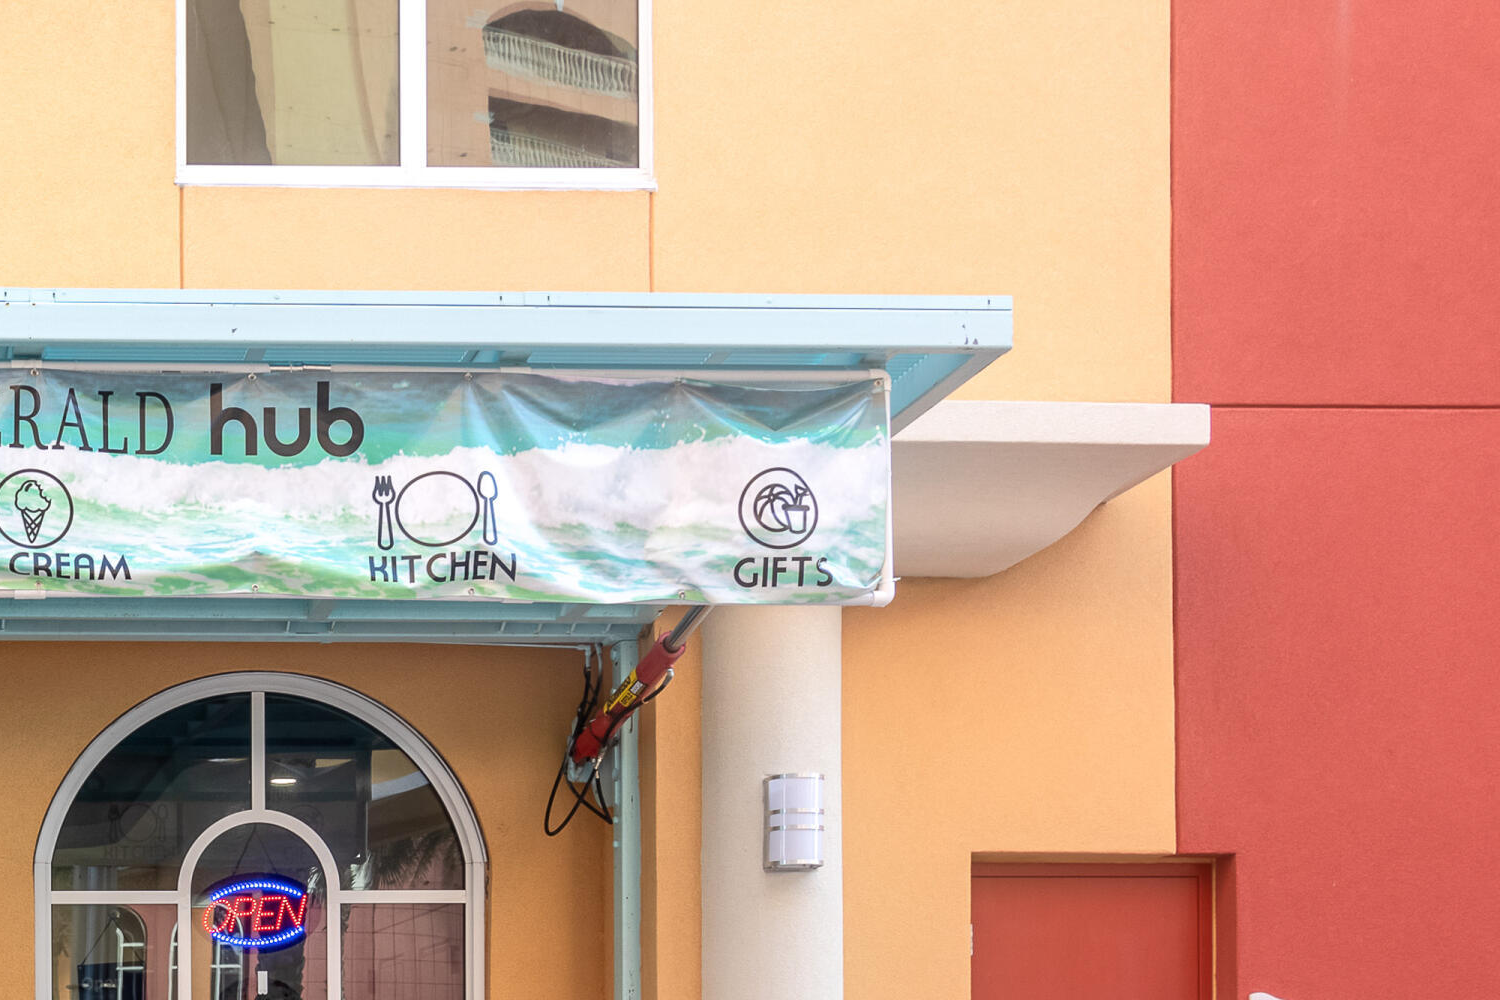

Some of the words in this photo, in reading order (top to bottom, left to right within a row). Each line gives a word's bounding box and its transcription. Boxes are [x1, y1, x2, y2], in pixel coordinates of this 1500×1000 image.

[209, 381, 364, 457] hub
[9, 551, 132, 581] CREAM
[369, 550, 517, 583] KITCHEN
[733, 557, 834, 589] GIFTS
[203, 894, 307, 933] OPEN
